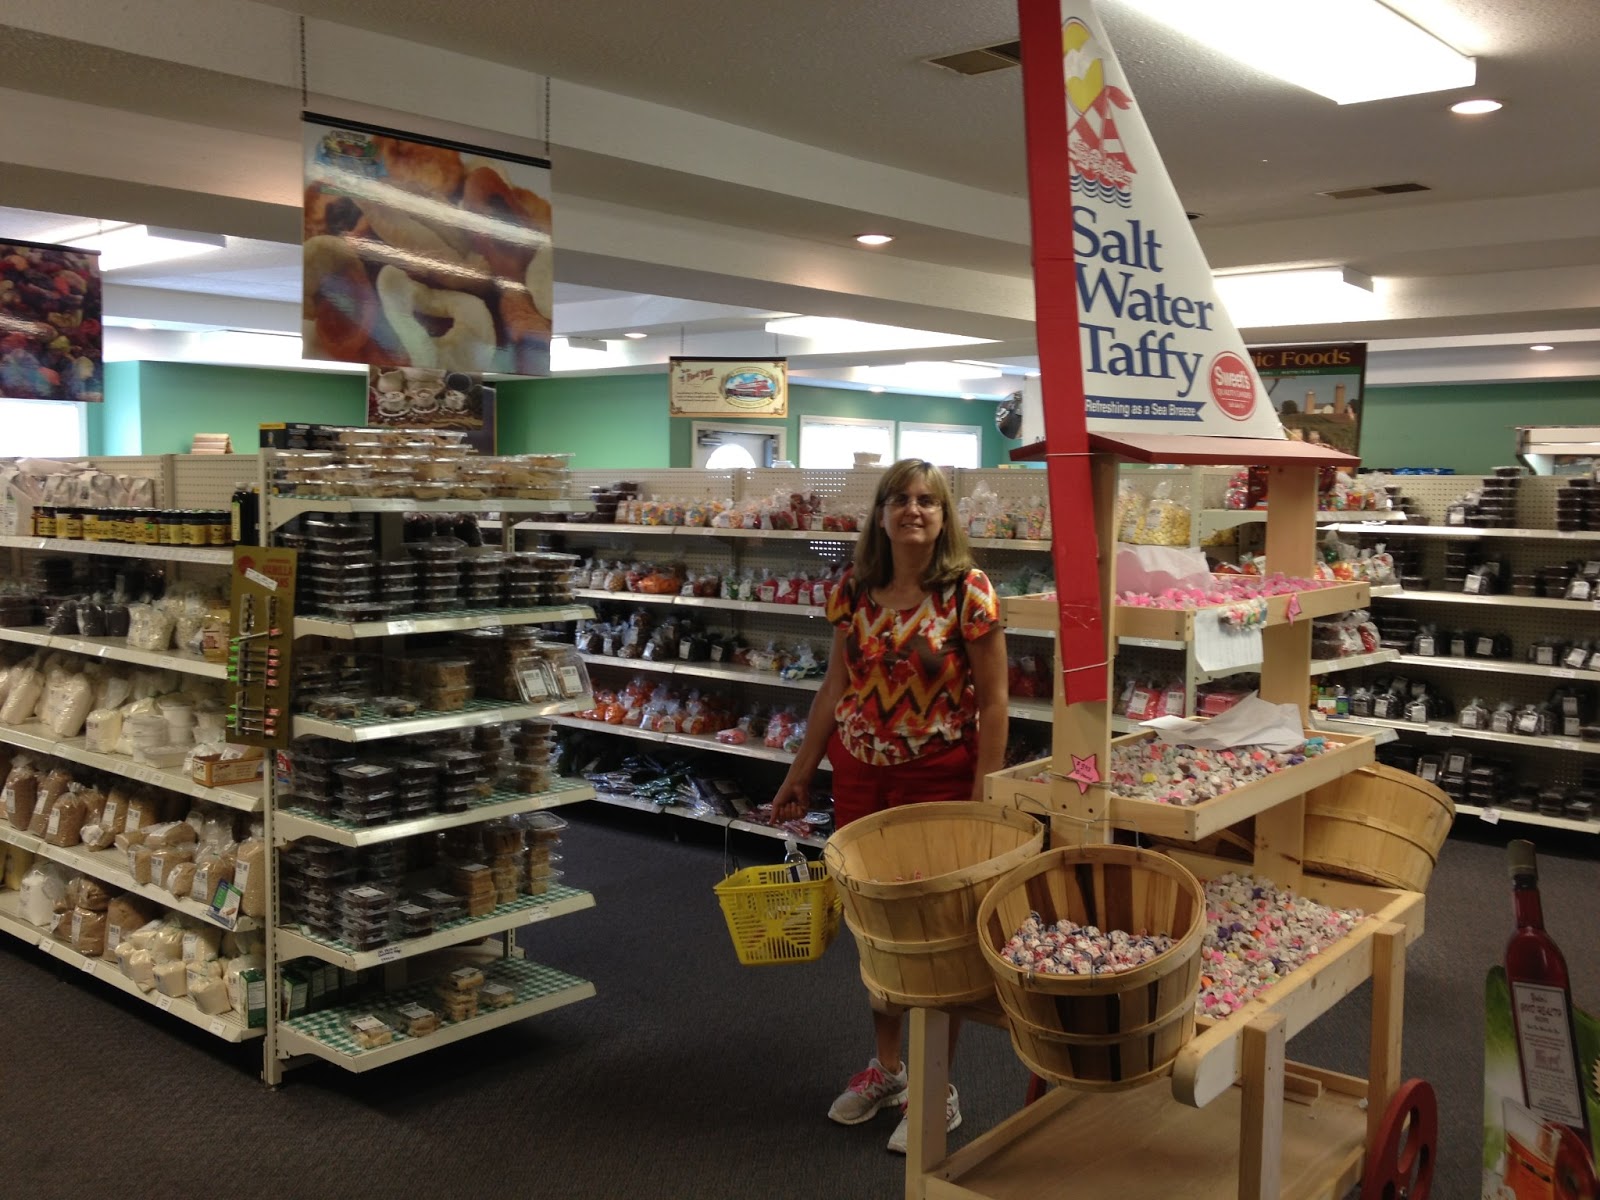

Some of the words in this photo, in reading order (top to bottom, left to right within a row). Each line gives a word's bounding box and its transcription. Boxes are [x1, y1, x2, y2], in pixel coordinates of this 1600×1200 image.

[1072, 205, 1164, 272] Salt
[1075, 262, 1214, 331] Water
[1079, 322, 1204, 398] Taffy
[1281, 348, 1351, 366] Foods
[1085, 399, 1131, 417] Refreshing
[1131, 404, 1143, 415] as
[1143, 405, 1150, 415] a
[1151, 403, 1168, 416] Sea
[1168, 404, 1197, 417] Breeze
